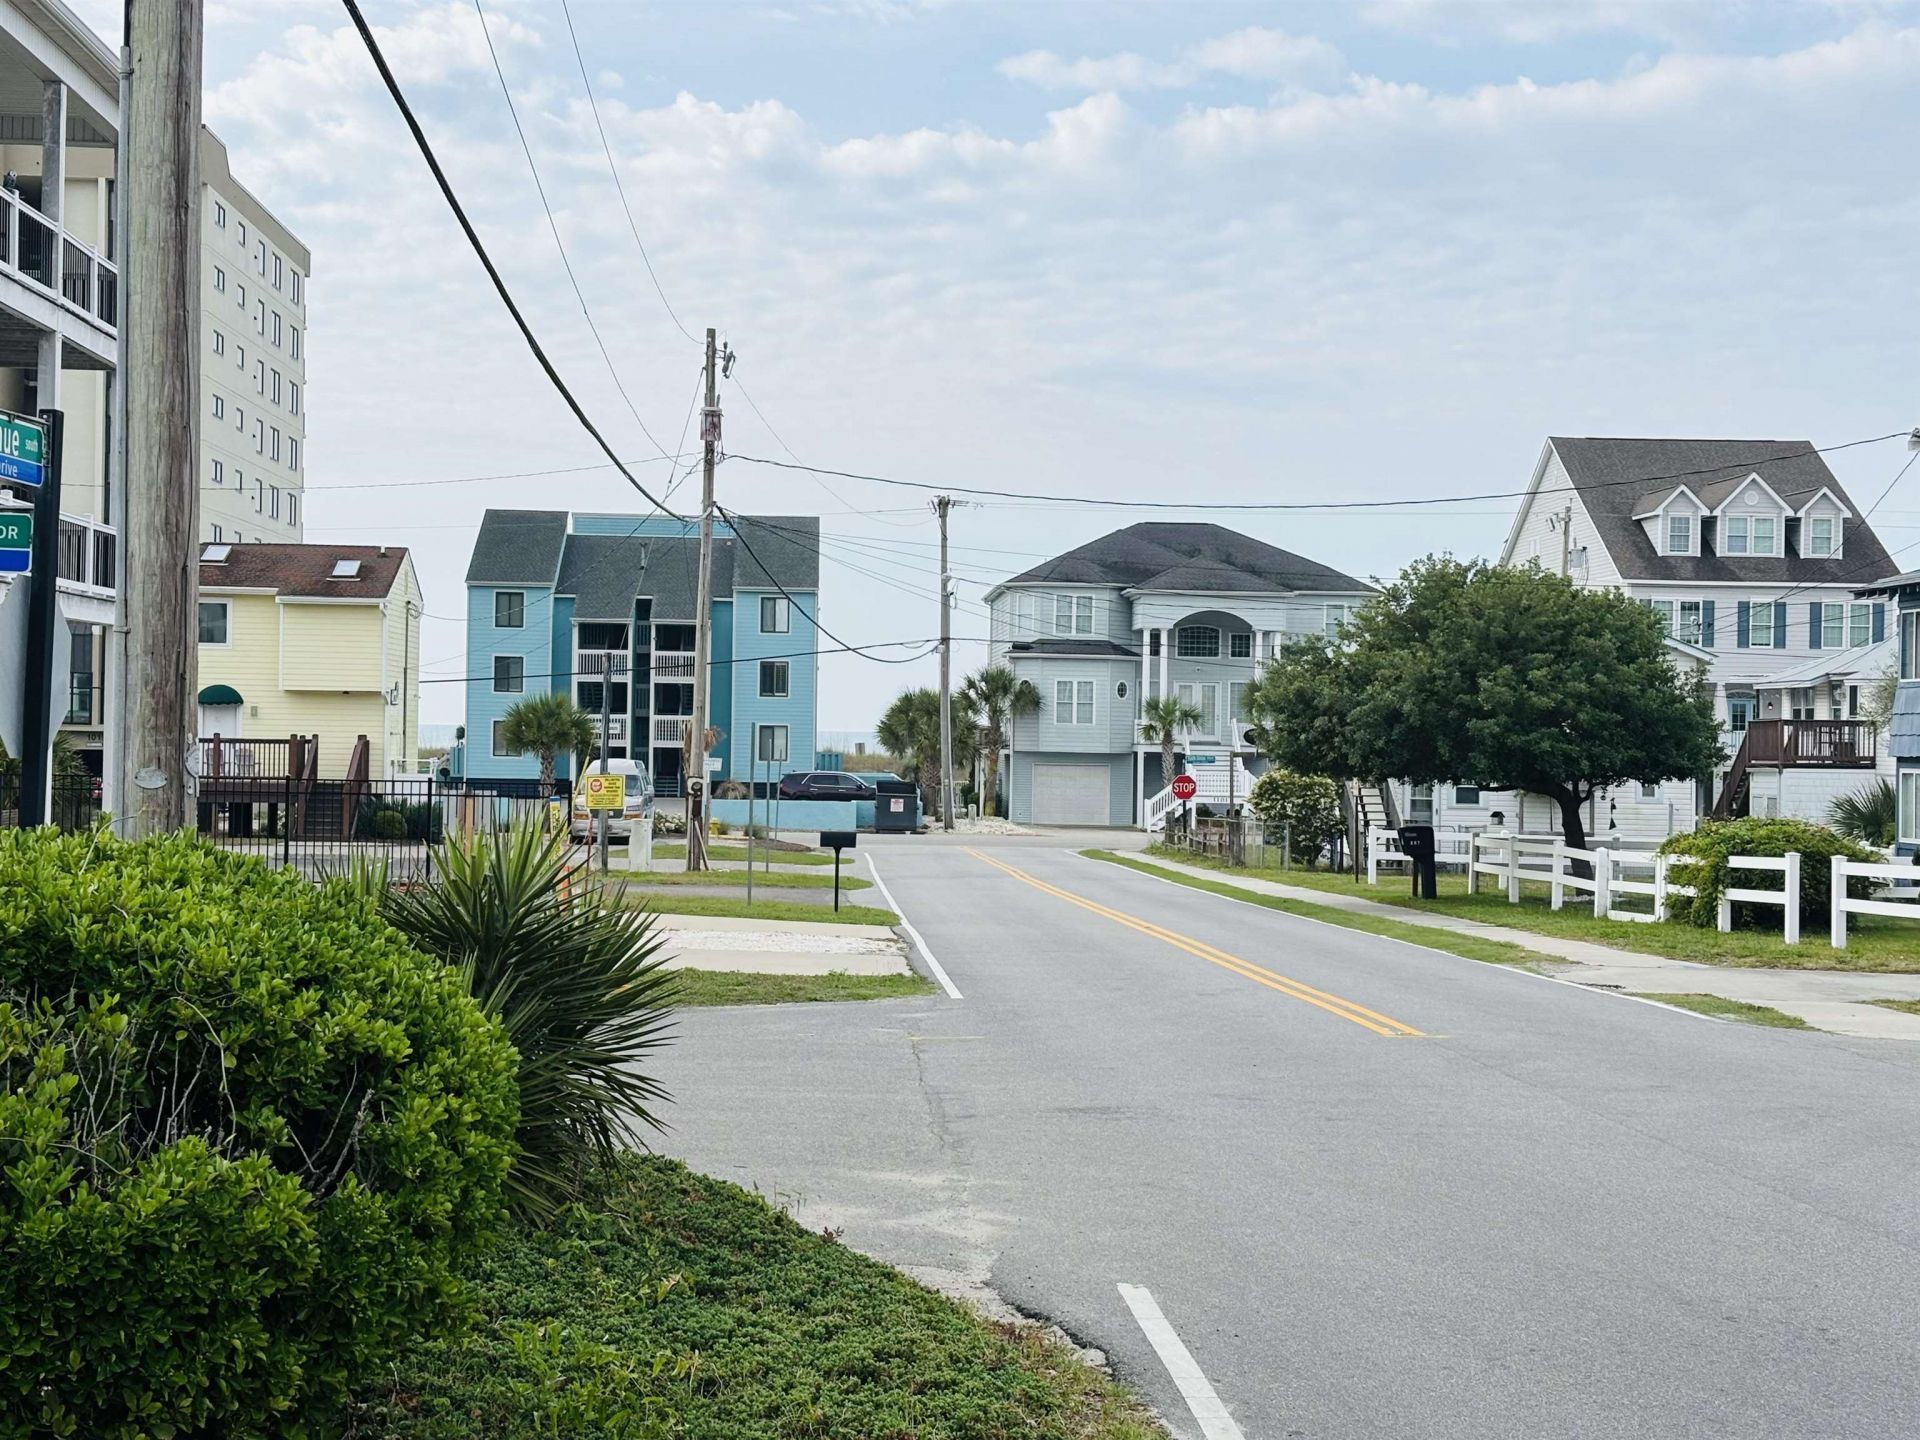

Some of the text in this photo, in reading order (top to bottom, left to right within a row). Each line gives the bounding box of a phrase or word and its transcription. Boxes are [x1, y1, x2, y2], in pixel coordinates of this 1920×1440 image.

[0, 426, 19, 456] ue
[0, 460, 18, 477] rive
[1173, 782, 1195, 793] STOP
